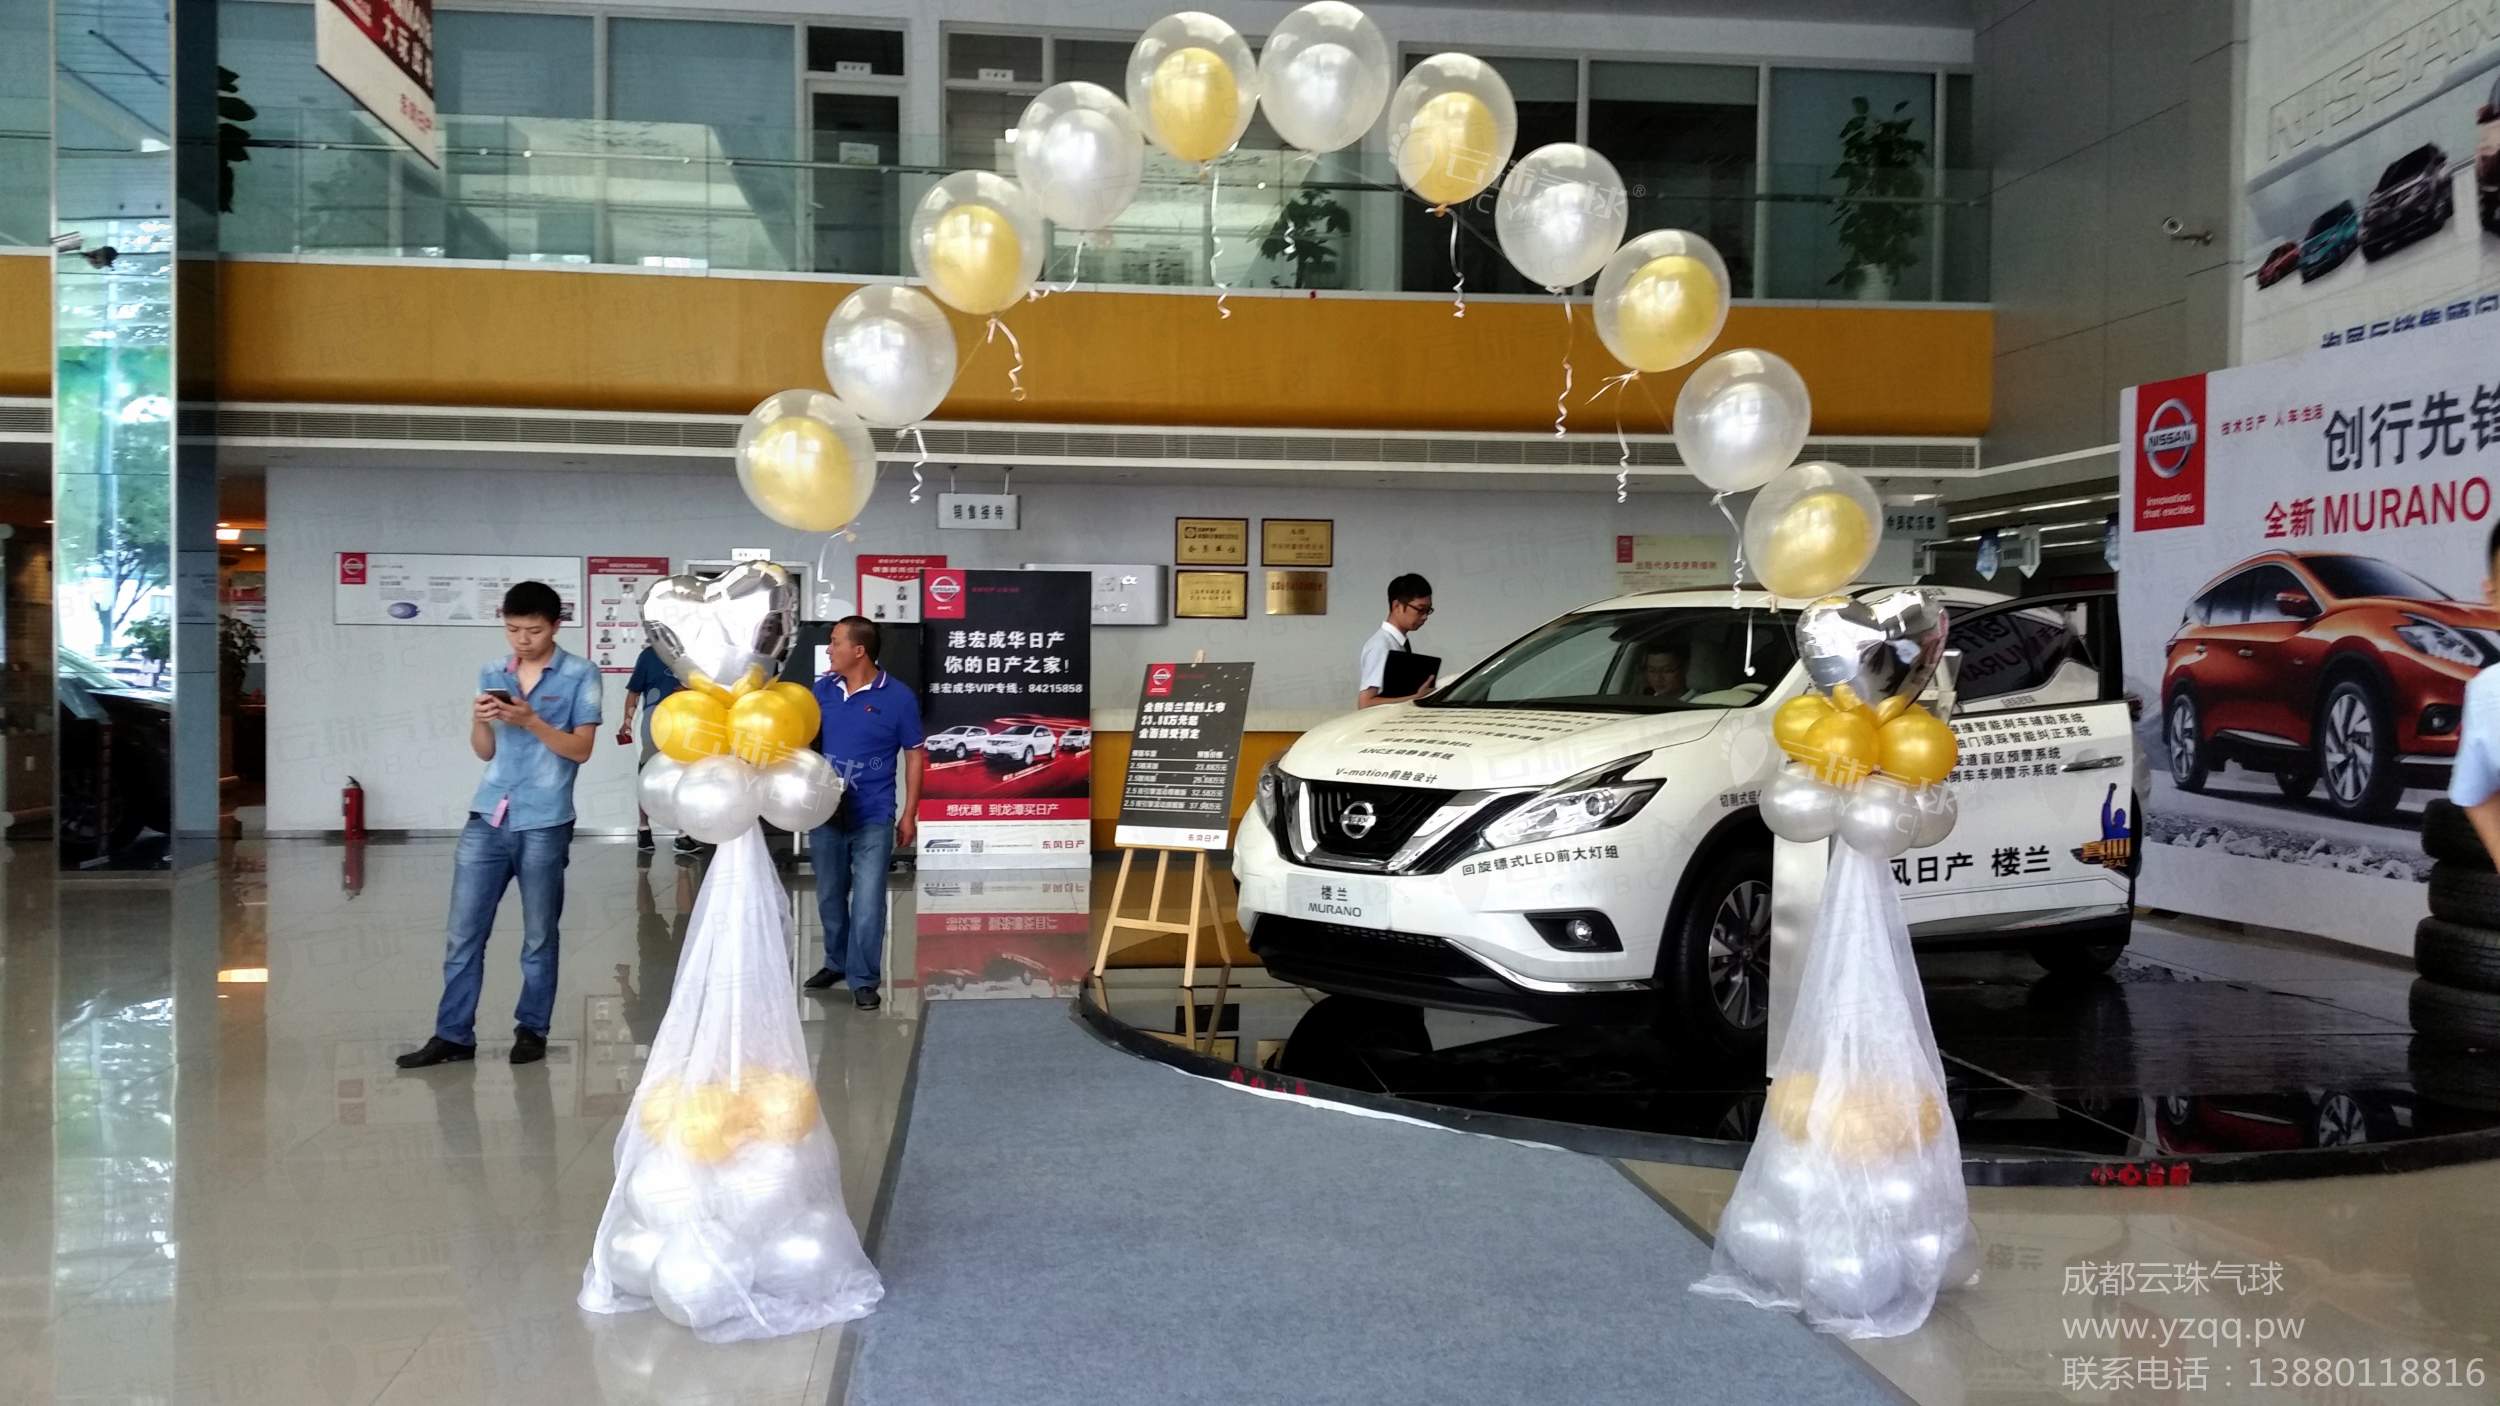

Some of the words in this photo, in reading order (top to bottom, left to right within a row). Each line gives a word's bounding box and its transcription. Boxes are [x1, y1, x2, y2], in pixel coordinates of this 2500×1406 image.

[2148, 431, 2191, 449] NISSAN
[2264, 496, 2316, 539] 全新
[2323, 475, 2492, 535] MURANO
[948, 630, 1066, 650] 港宏成华日产
[1335, 766, 1438, 785] V-motion前脸设计
[946, 803, 983, 817] 想优惠
[1041, 839, 1086, 850] 东风日产
[1461, 844, 1620, 877] 回旋镖式LED前大灯组
[1991, 844, 2051, 877] 楼兰
[1321, 884, 1348, 902] 楼兰
[1308, 901, 1362, 918] MURANO
